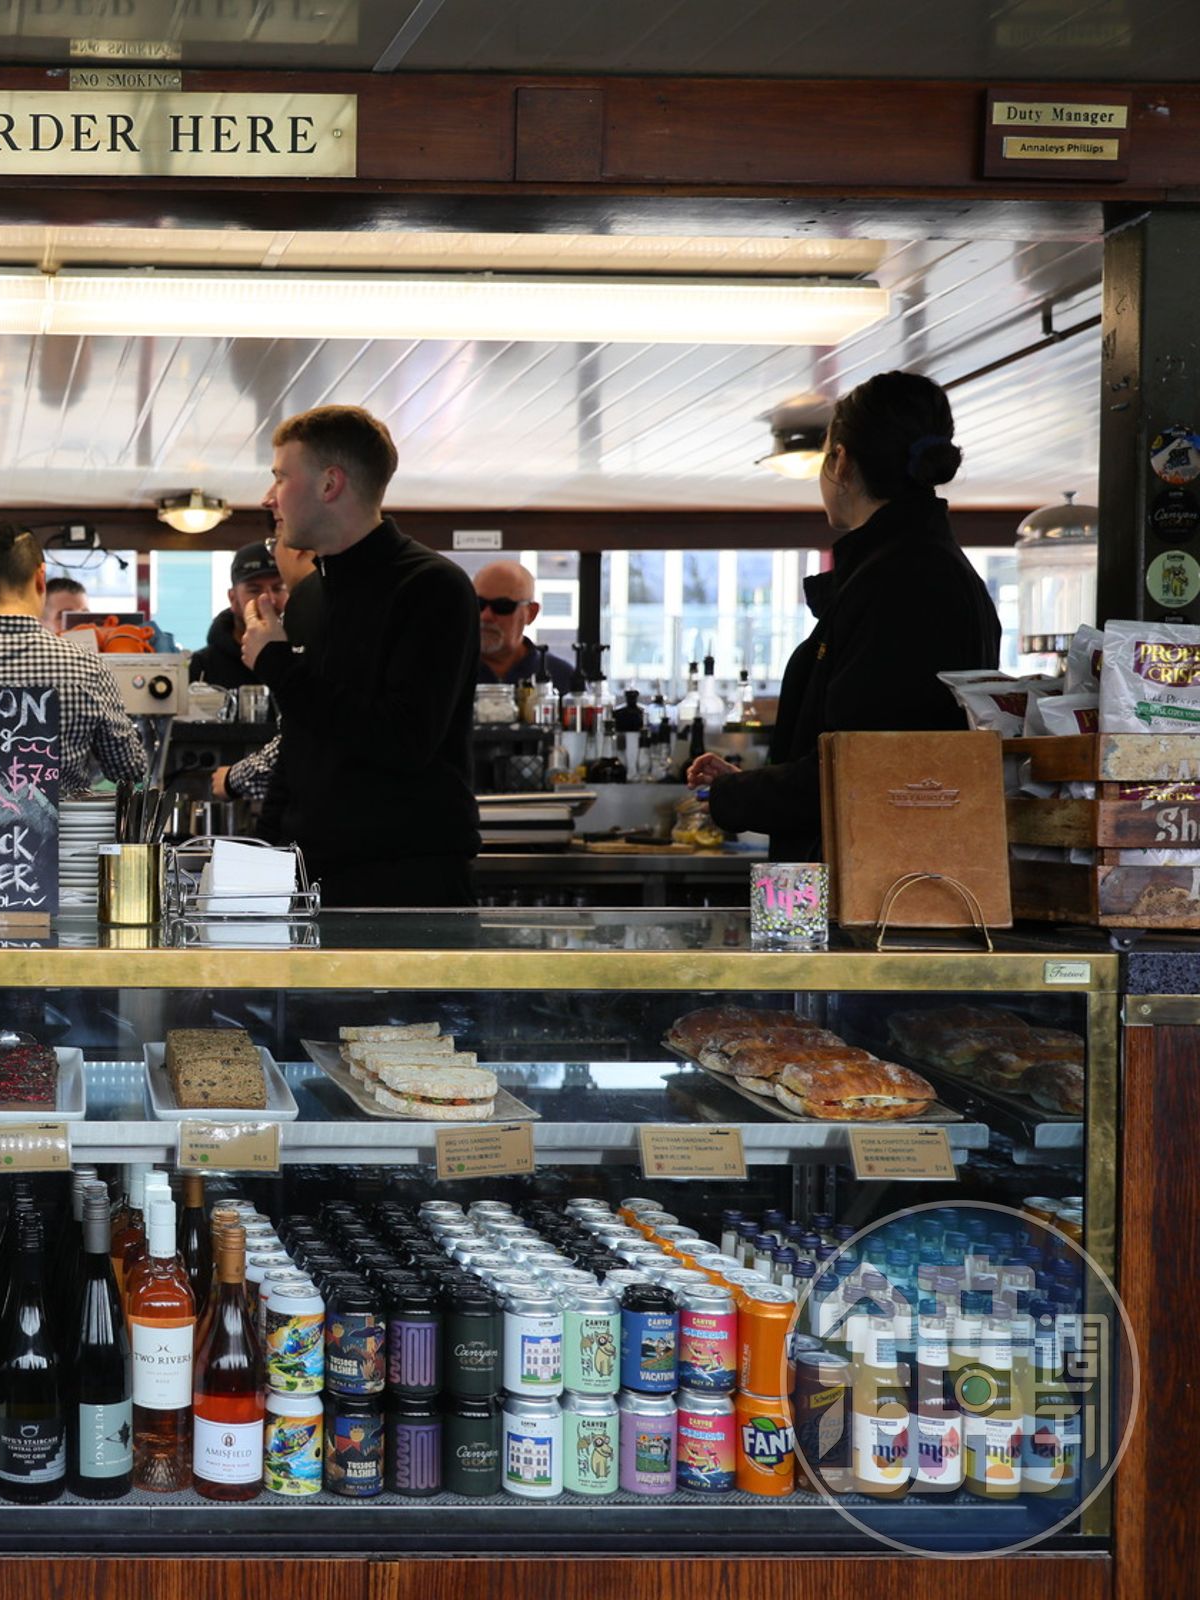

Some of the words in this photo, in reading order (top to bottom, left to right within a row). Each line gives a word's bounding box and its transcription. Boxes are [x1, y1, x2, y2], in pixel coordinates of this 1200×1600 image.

[79, 73, 99, 87] NO
[1006, 106, 1043, 123] Duty
[1052, 107, 1115, 126] Manager
[169, 114, 319, 154] HERE
[1155, 806, 1200, 842] Sh
[756, 876, 817, 921] Tips
[134, 1353, 155, 1364] TWO
[454, 1344, 498, 1362] Canyon
[205, 1447, 252, 1459] AMISFIELD
[456, 1445, 498, 1464] Canyon
